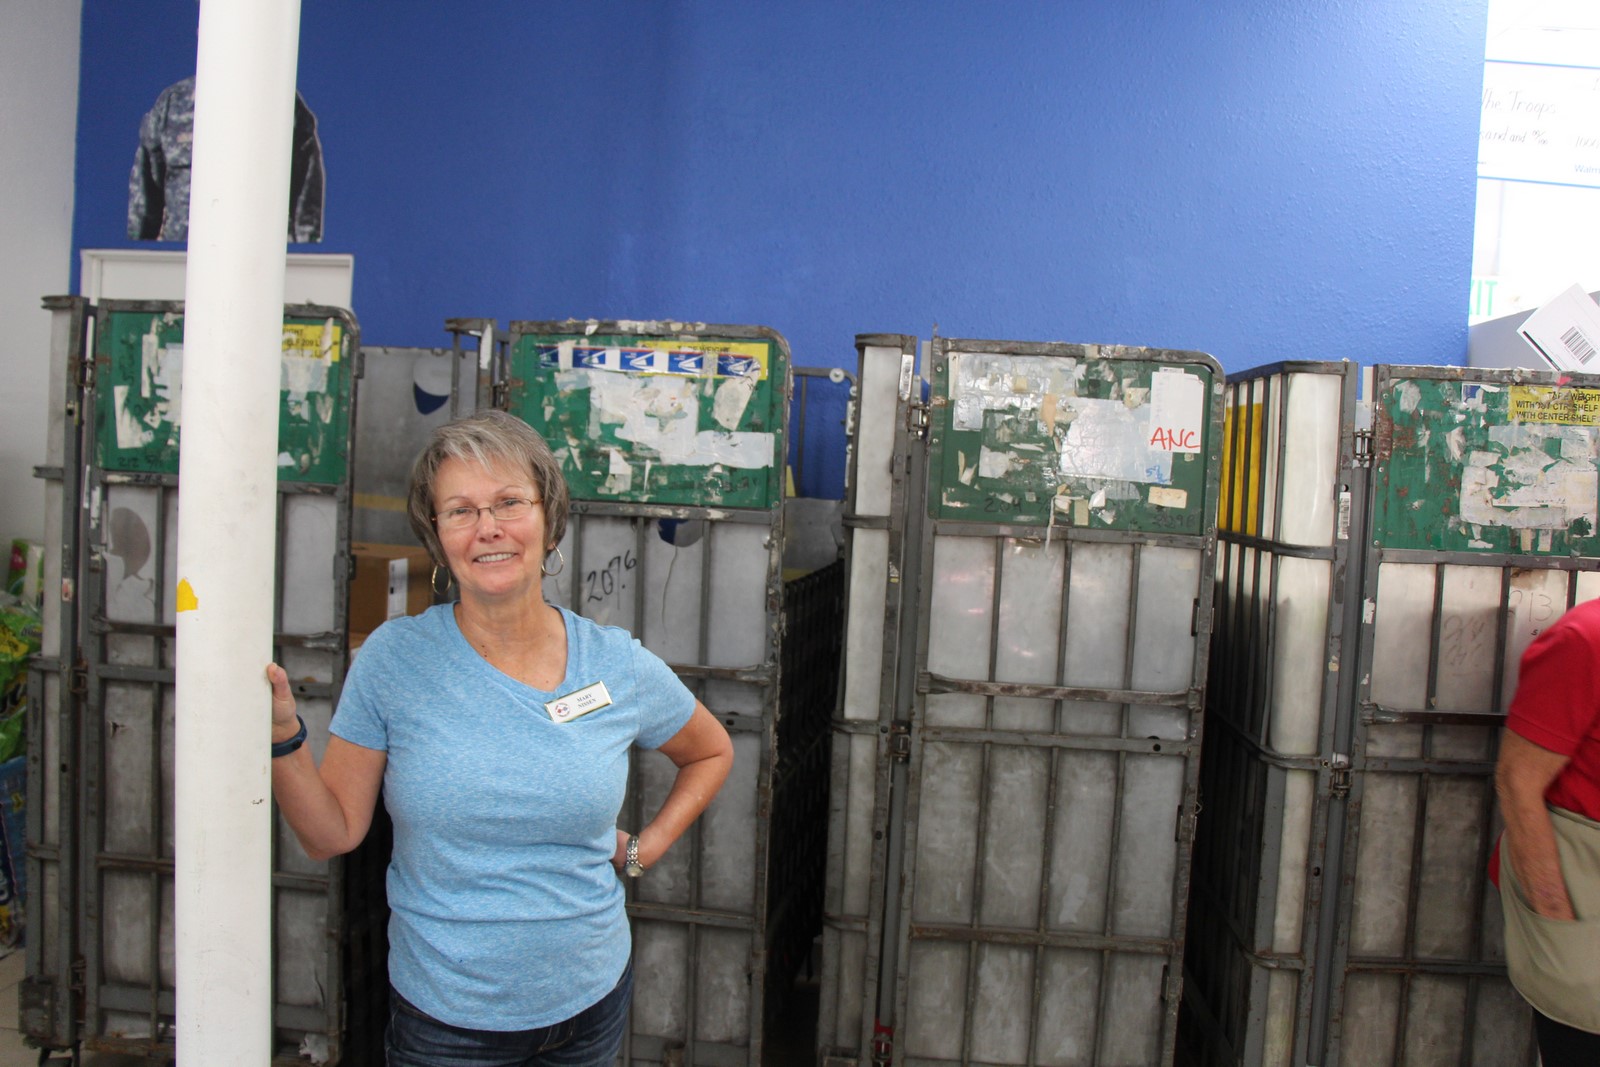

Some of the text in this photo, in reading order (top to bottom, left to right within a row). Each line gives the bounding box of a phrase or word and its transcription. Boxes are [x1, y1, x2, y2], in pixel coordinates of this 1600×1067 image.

[1508, 89, 1557, 120] Troops
[1509, 131, 1528, 143] and
[1516, 411, 1536, 420] WITH
[1537, 411, 1569, 421] CENTER
[1150, 426, 1201, 451] ANC
